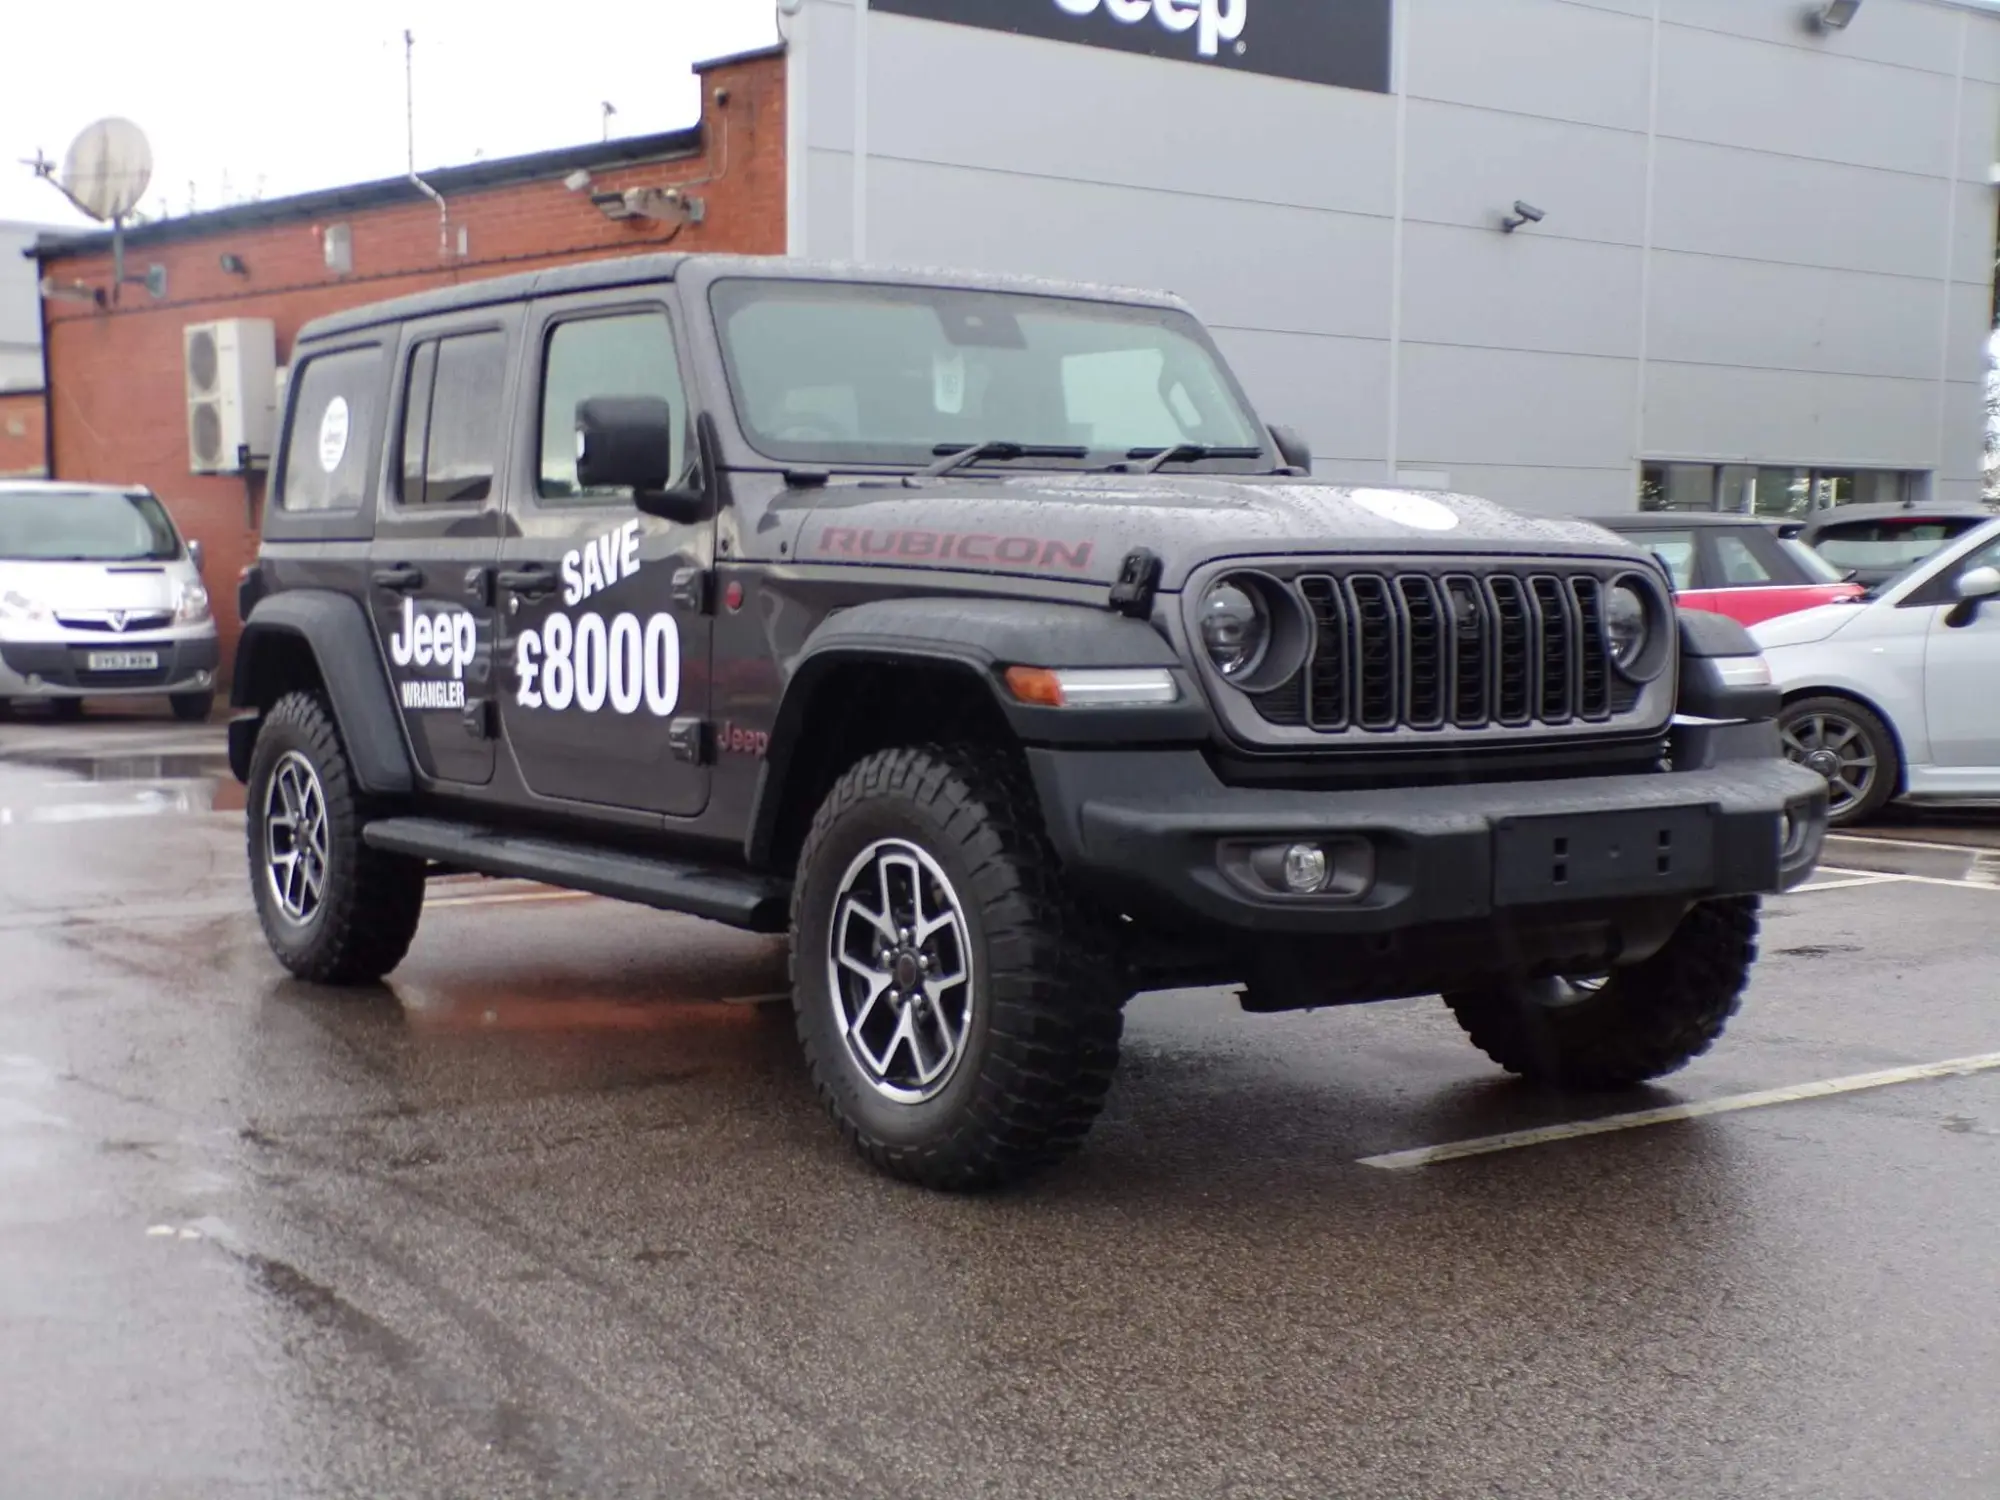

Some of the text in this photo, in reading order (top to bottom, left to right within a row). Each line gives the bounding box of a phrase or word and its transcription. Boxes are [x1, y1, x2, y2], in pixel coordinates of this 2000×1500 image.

[1053, 0, 1247, 56] ep
[562, 518, 641, 607] SAVE
[817, 525, 1095, 572] RUBICON
[391, 596, 477, 680] Jeep
[516, 612, 680, 716] £8000
[402, 681, 465, 708] WRANGLER
[717, 720, 769, 761] Jeep
